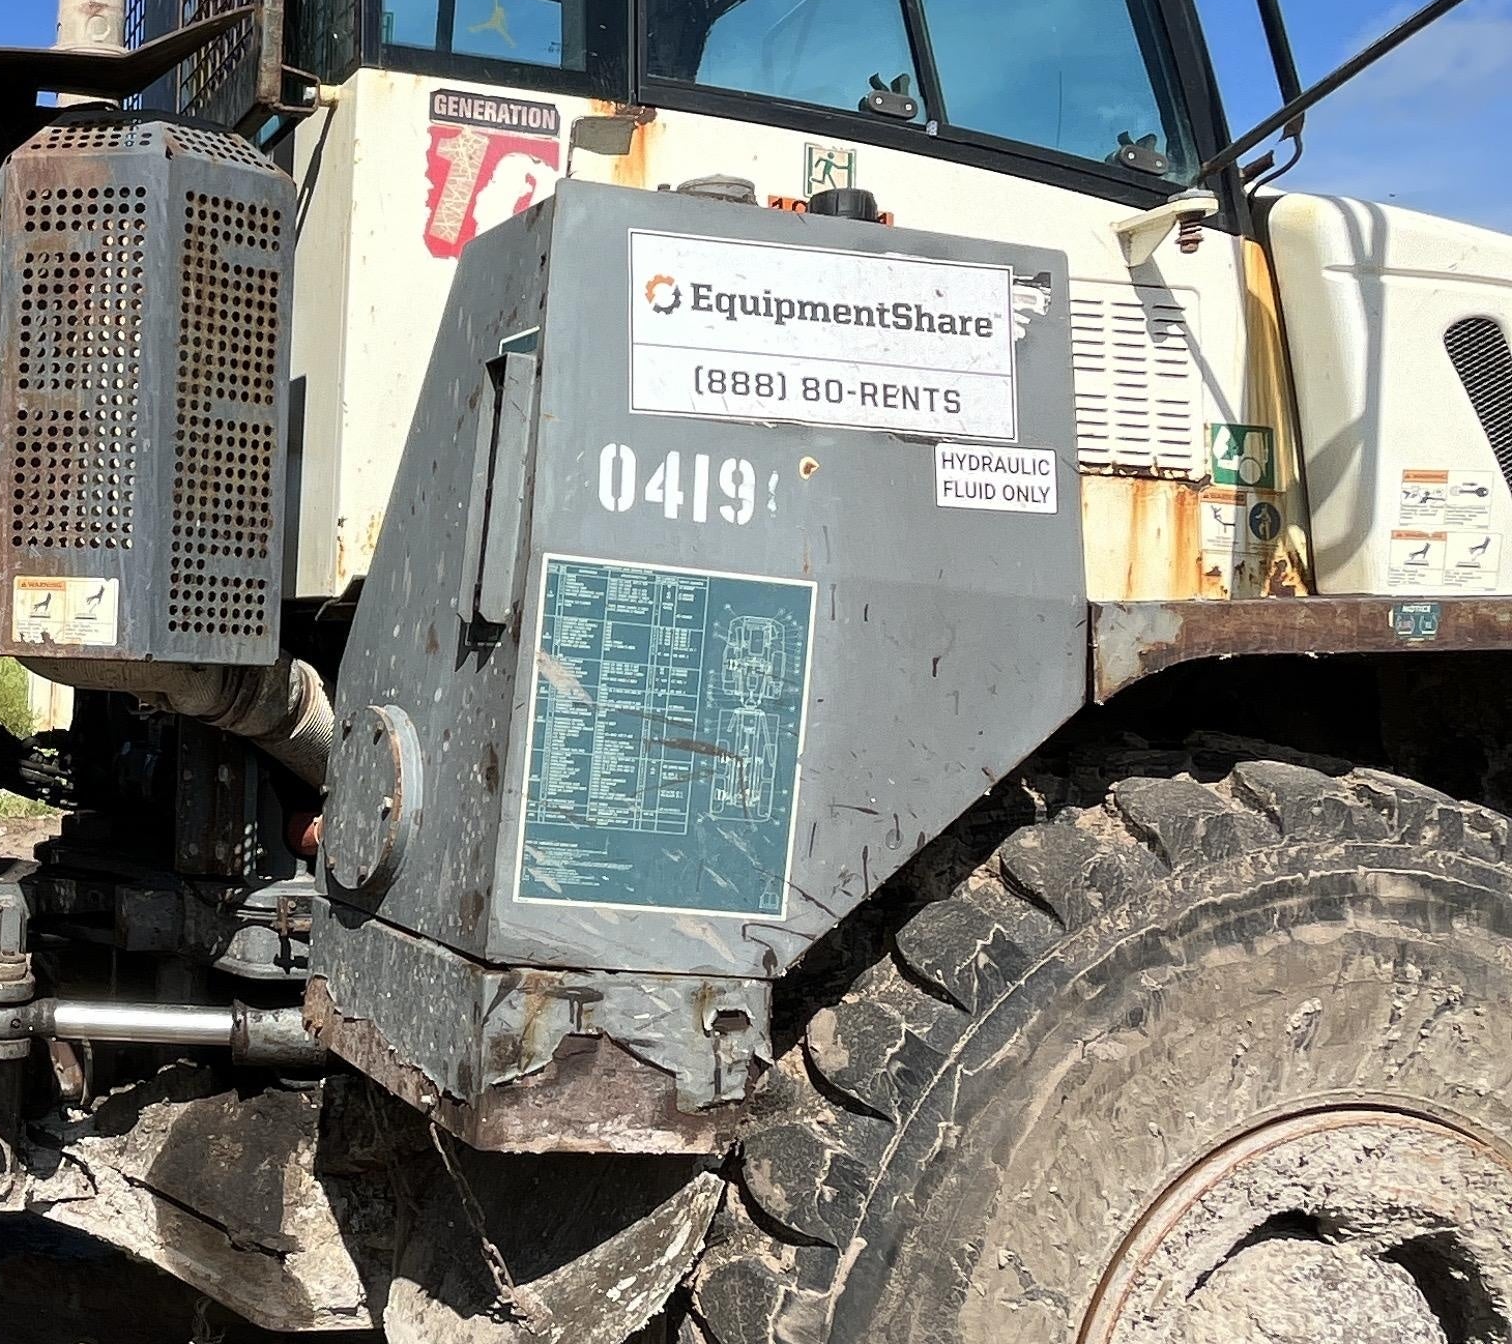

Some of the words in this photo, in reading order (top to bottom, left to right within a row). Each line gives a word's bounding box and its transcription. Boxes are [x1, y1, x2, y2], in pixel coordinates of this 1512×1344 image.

[434, 94, 555, 131] GENERATION
[690, 282, 993, 338] EquipmentShare
[694, 365, 787, 400] (888)
[802, 377, 961, 414] 80-RENTS
[599, 443, 779, 526] 0419
[942, 452, 1050, 476] HYDRAULIC
[943, 480, 996, 500] FLUID
[1002, 485, 1050, 504] ONLY
